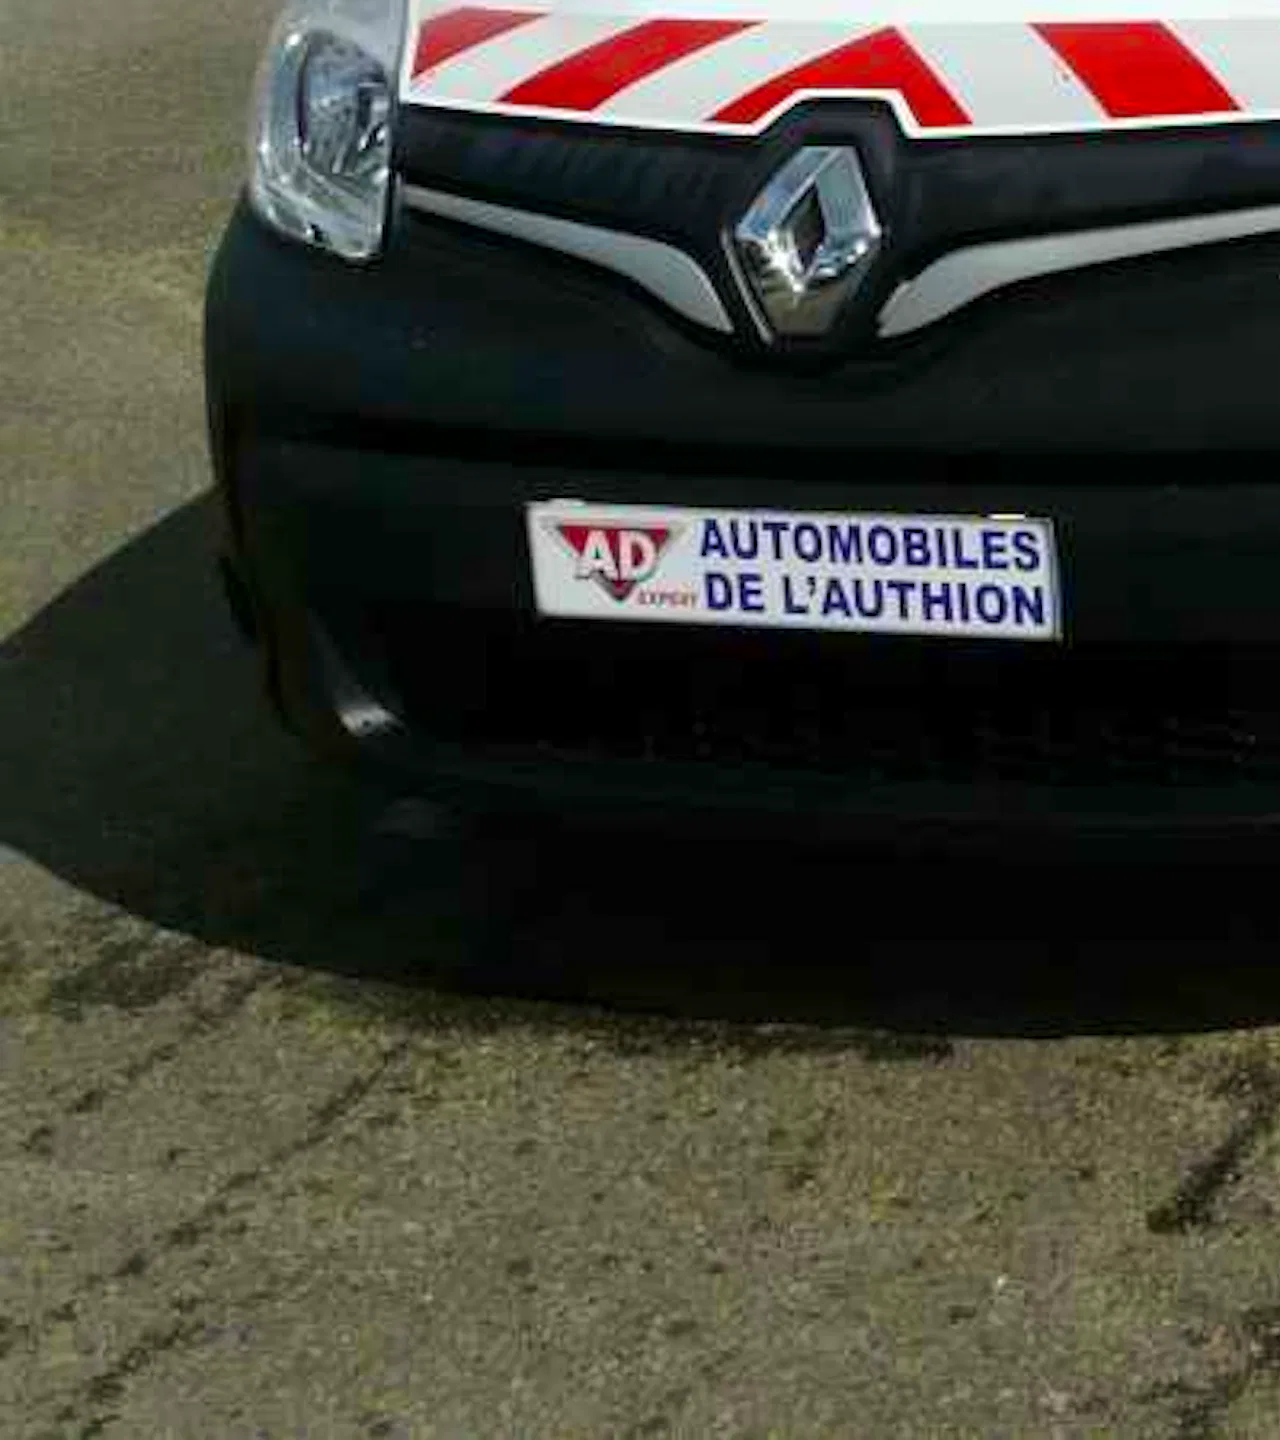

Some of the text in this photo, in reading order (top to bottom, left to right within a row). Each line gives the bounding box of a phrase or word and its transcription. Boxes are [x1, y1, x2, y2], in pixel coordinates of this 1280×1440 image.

[576, 528, 658, 581] AD
[701, 518, 1041, 572] AUTOMOBILES
[705, 572, 1045, 626] DE L'AUTHION
